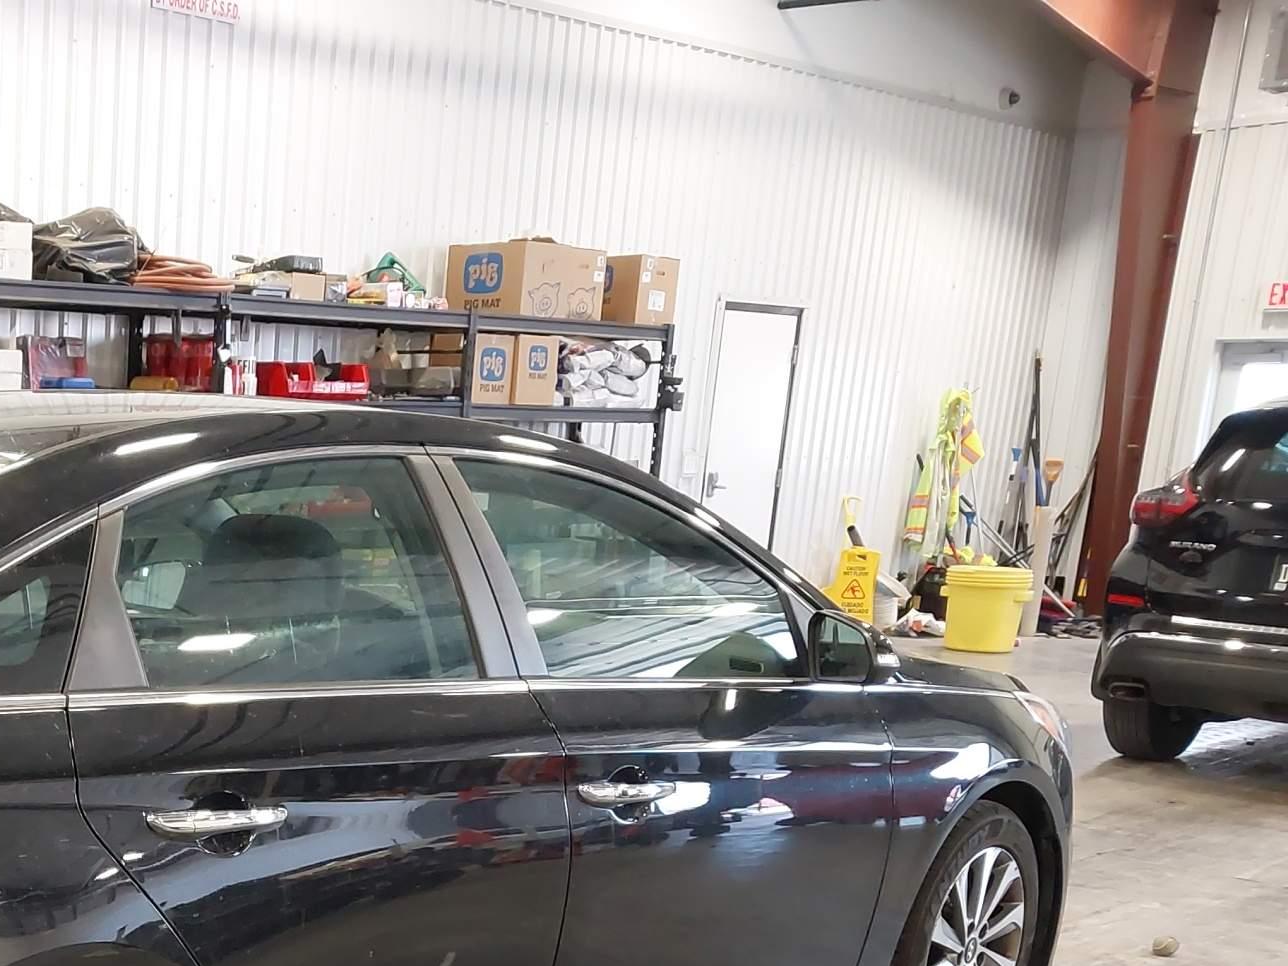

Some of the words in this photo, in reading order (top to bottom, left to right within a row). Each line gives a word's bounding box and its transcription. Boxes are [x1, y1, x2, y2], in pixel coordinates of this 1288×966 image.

[481, 298, 502, 309] MAT
[479, 383, 491, 393] PIG
[491, 383, 505, 393] MAT
